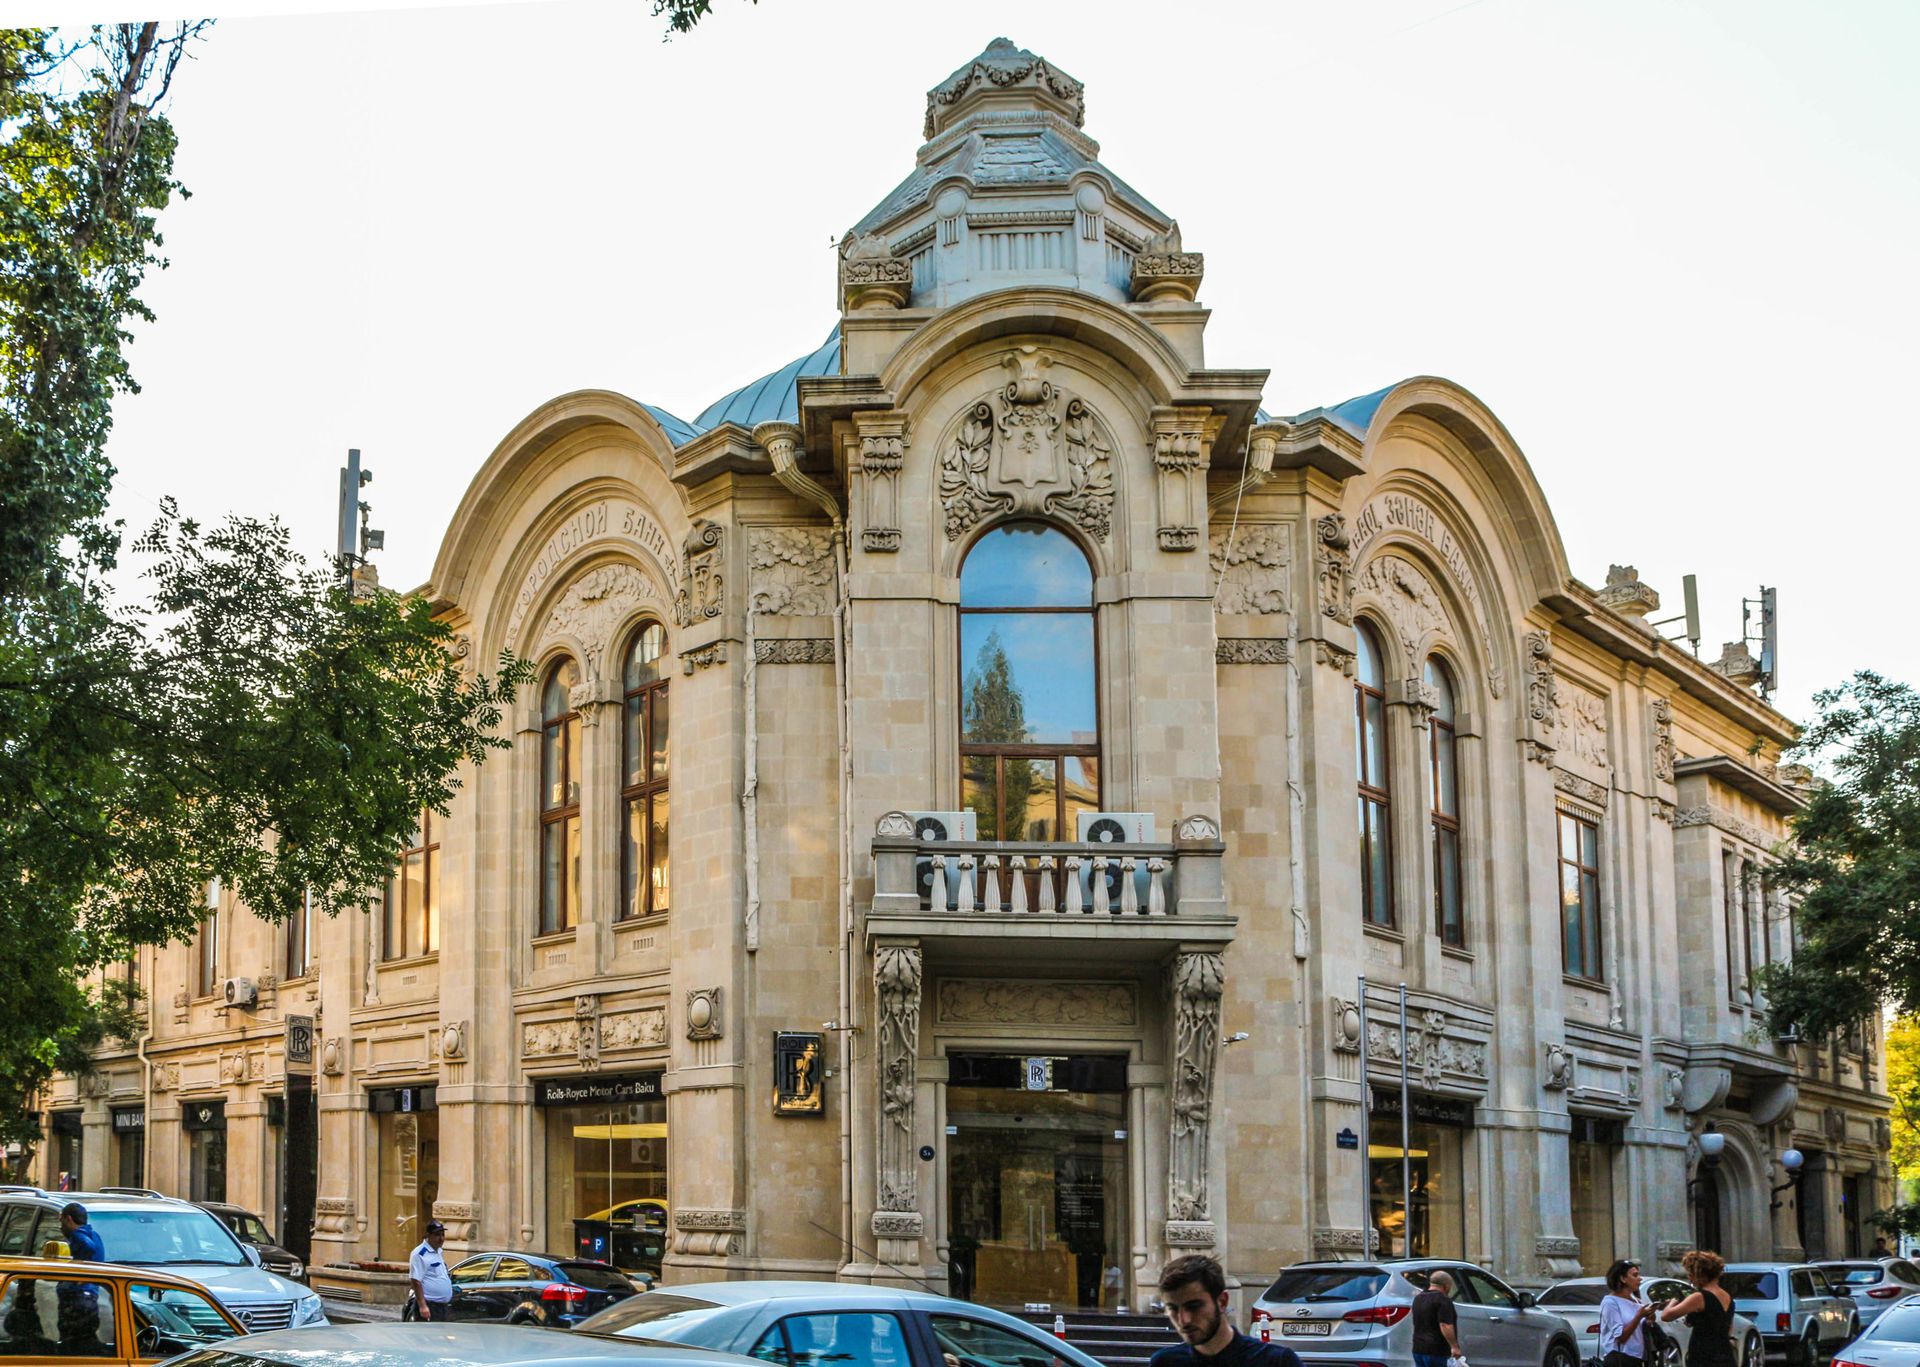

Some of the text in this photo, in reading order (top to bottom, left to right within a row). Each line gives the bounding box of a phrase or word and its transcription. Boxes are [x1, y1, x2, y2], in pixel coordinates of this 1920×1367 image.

[547, 1082, 655, 1100] Rolls-Royce Motor Cars Baku
[116, 1114, 130, 1127] MINI
[595, 1239, 602, 1250] P
